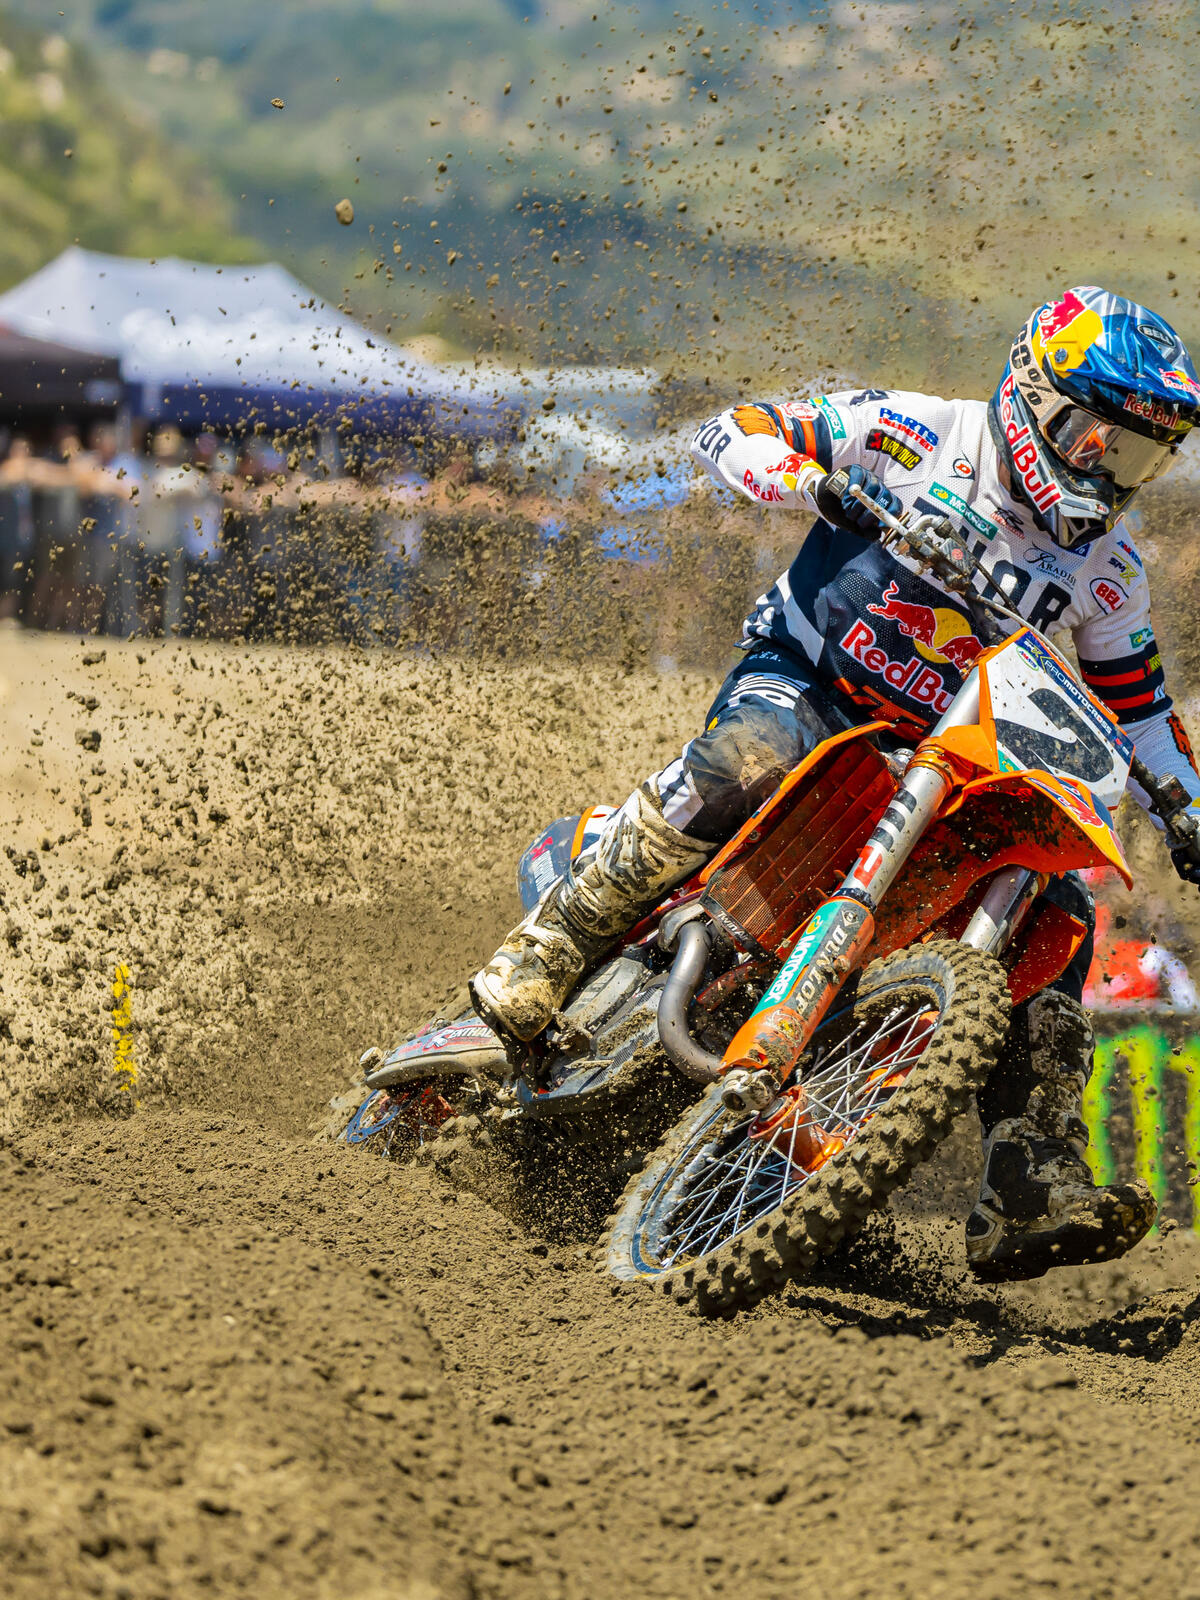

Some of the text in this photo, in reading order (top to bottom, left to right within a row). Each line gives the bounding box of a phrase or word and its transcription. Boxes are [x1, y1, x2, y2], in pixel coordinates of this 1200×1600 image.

[879, 407, 939, 447] PARTS
[841, 620, 956, 716] Red Bu
[763, 934, 816, 1003] MOTOREX
